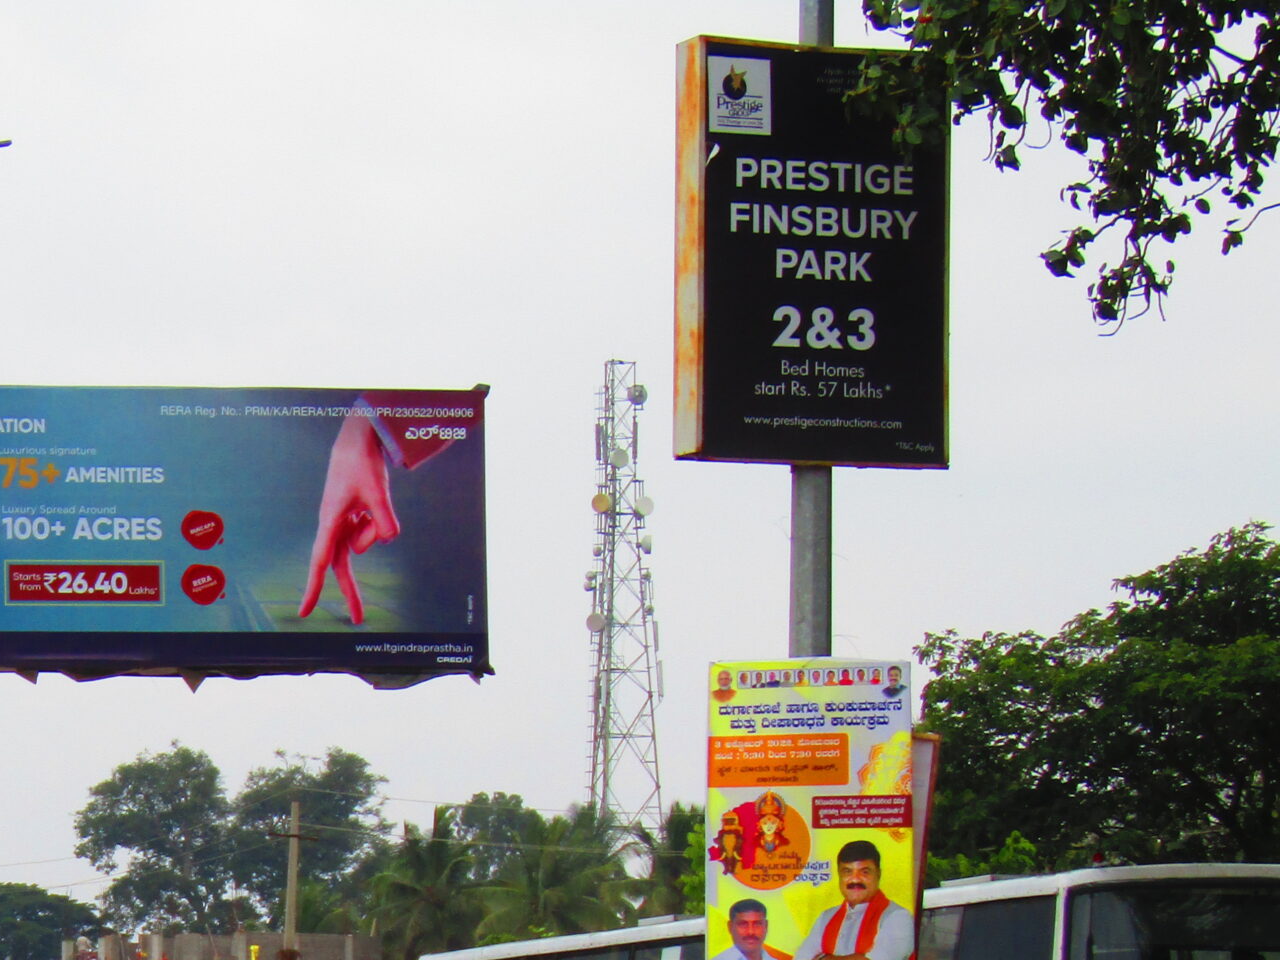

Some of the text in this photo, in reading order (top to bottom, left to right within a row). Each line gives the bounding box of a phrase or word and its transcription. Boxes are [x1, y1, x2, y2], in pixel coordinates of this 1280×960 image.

[717, 96, 763, 113] Prestige
[735, 157, 913, 195] PRESTIGE
[729, 202, 918, 240] FINSBURY
[775, 248, 873, 282] PARK
[771, 305, 876, 351] 2&3
[781, 360, 865, 378] Bed Homes
[754, 382, 786, 396] start
[791, 381, 811, 397] Rs.
[817, 382, 837, 397] 57
[160, 405, 192, 416] RERA
[194, 406, 218, 418] Reg.
[744, 415, 903, 430] www.prestigeconstructions.com
[49, 446, 96, 457] signature
[65, 466, 165, 483] AMENITIES
[1, 505, 117, 515] Luxury Spread Around
[2, 516, 163, 540] 100+ ACRES
[13, 572, 41, 581] Starts
[43, 571, 128, 594] ₹26.40
[19, 583, 41, 591] from
[355, 643, 473, 653] www.ltgindraprastha.in
